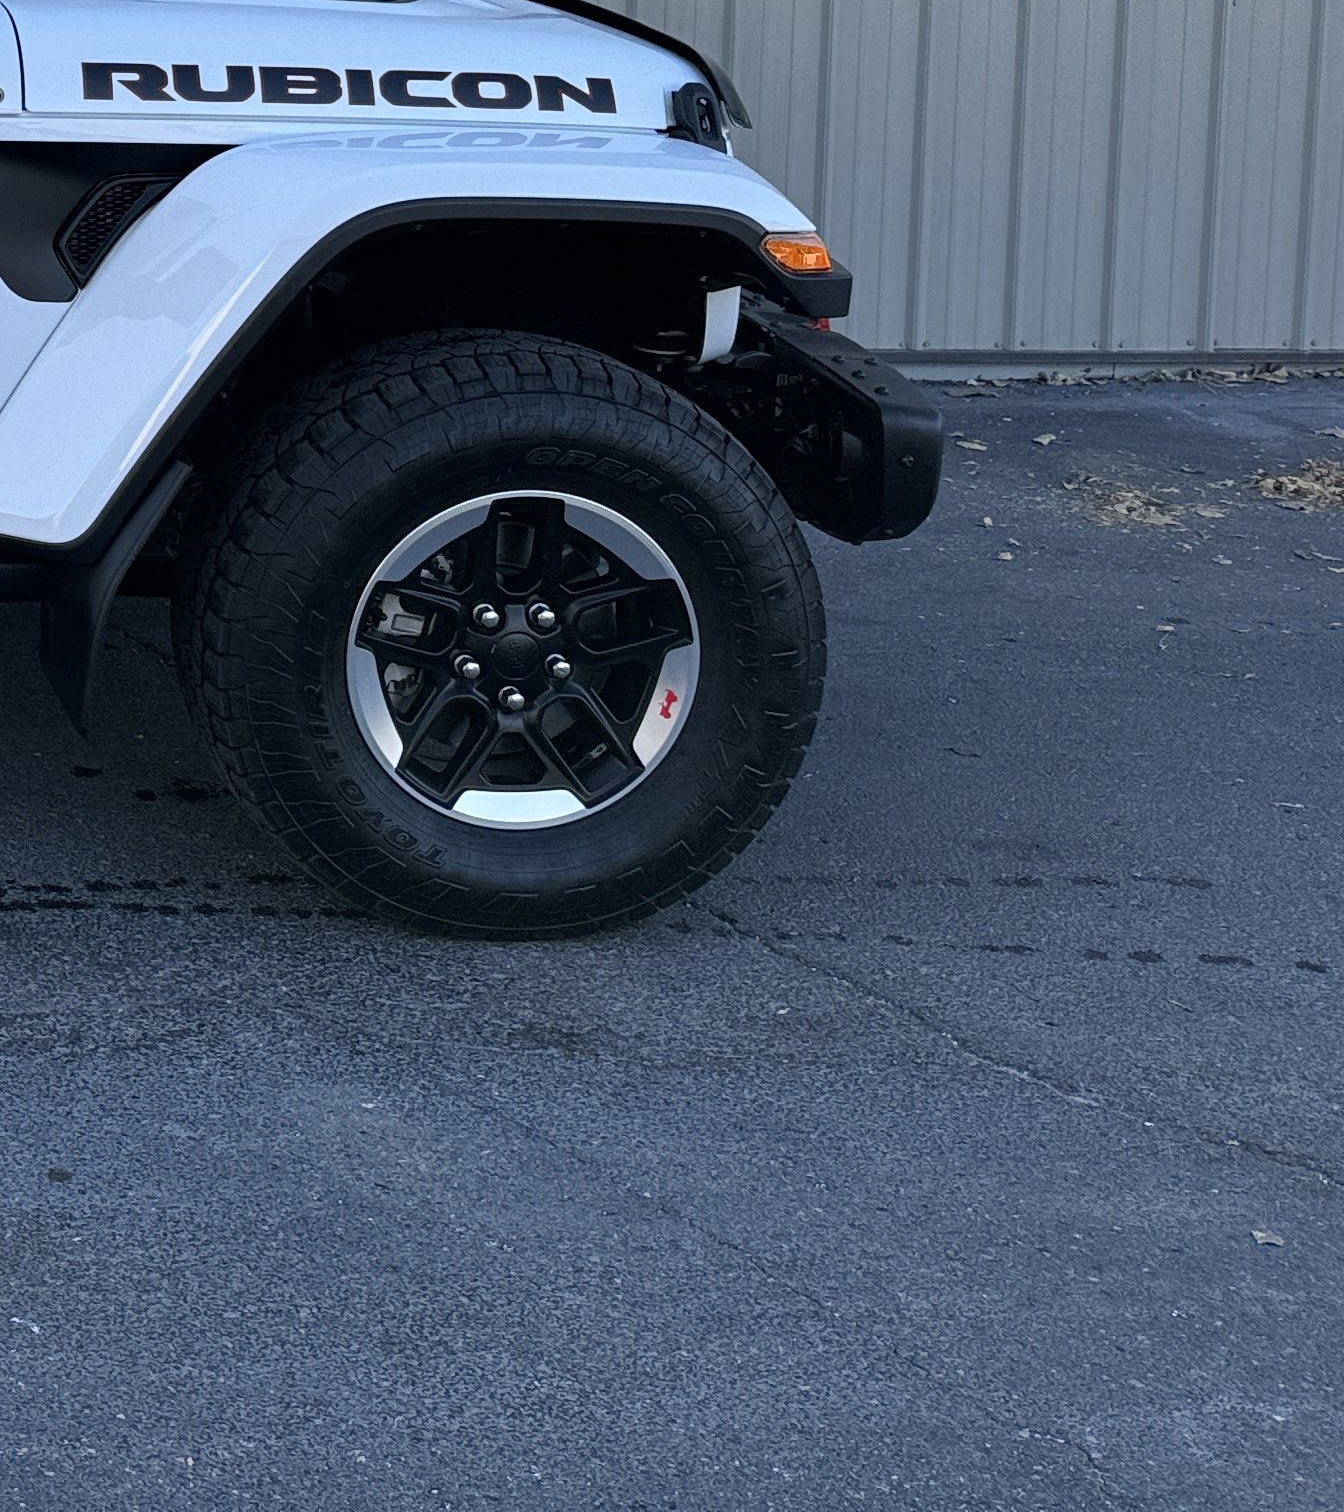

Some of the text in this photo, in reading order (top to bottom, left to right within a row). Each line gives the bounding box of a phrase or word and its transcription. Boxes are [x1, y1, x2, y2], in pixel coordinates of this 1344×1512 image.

[81, 62, 618, 114] RUBICON
[524, 446, 663, 493] OPEN
[334, 774, 449, 871] TOYO
